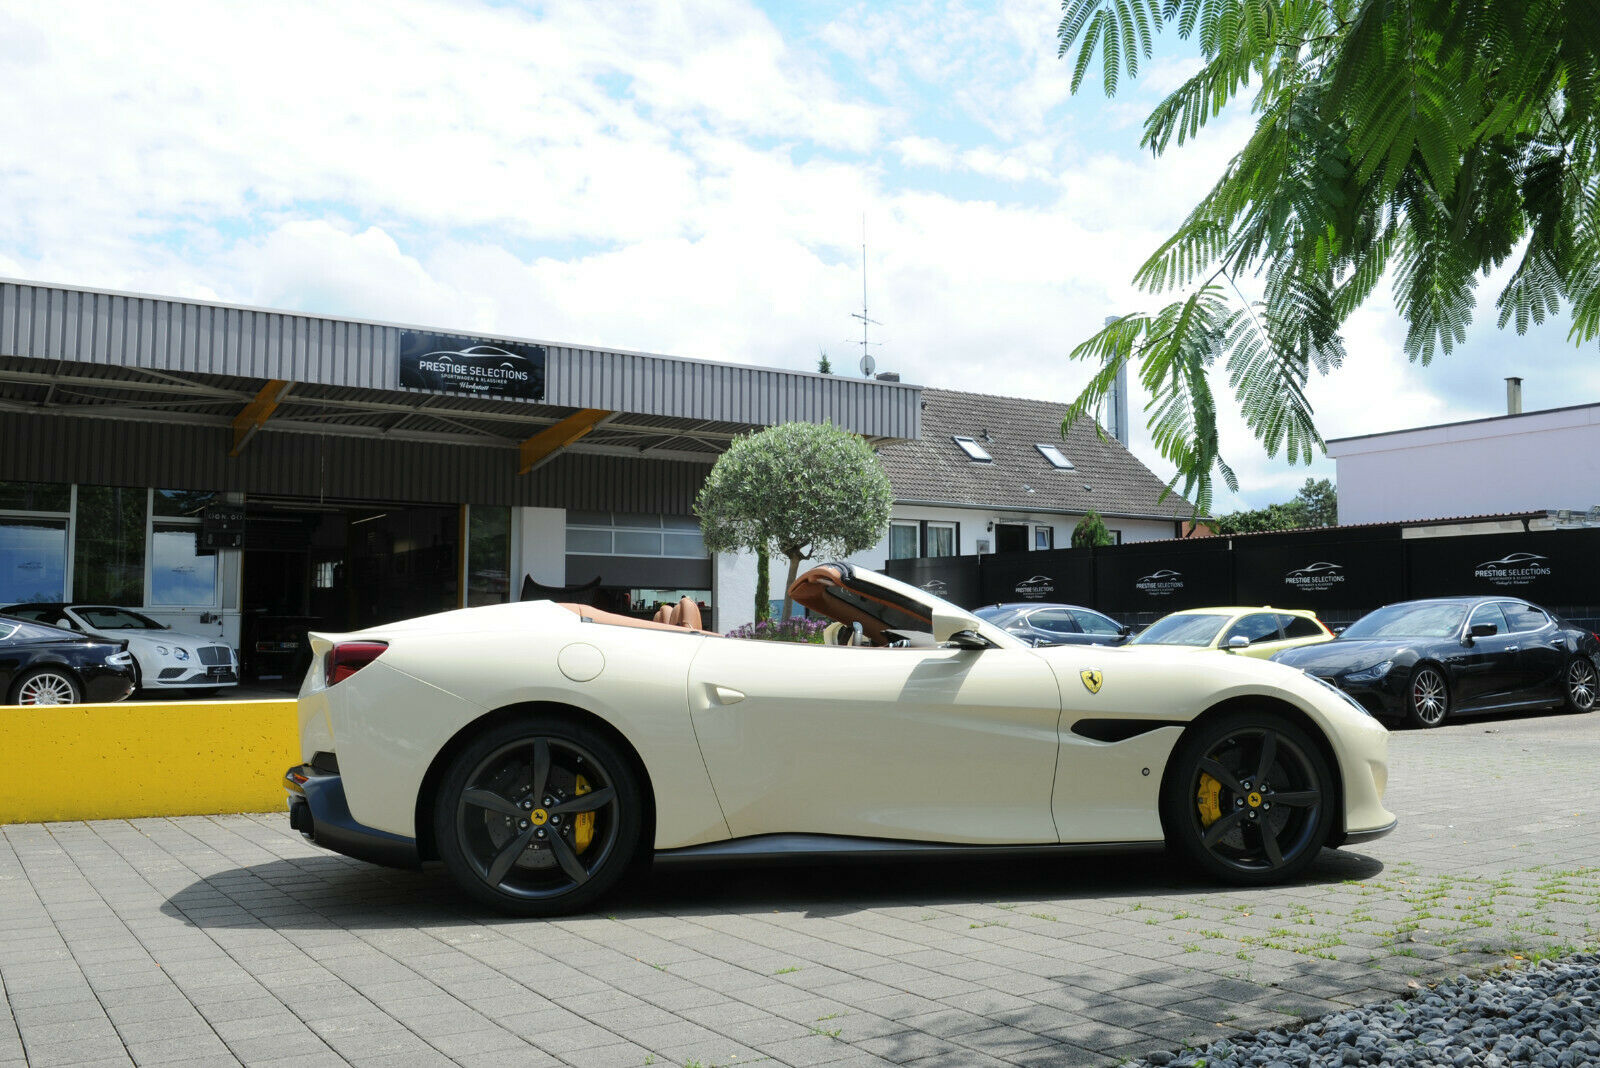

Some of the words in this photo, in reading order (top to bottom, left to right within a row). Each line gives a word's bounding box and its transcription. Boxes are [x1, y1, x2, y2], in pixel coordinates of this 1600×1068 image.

[419, 360, 468, 375] PRESTIGE
[469, 366, 528, 381] SELECTIONS
[441, 373, 474, 382] SPORTWAGEN
[1474, 569, 1507, 577] PRESTIGE
[1508, 568, 1551, 576] SELECTIONS
[1285, 576, 1310, 584] PRESTIGE
[1311, 575, 1345, 583] SELECTIONS
